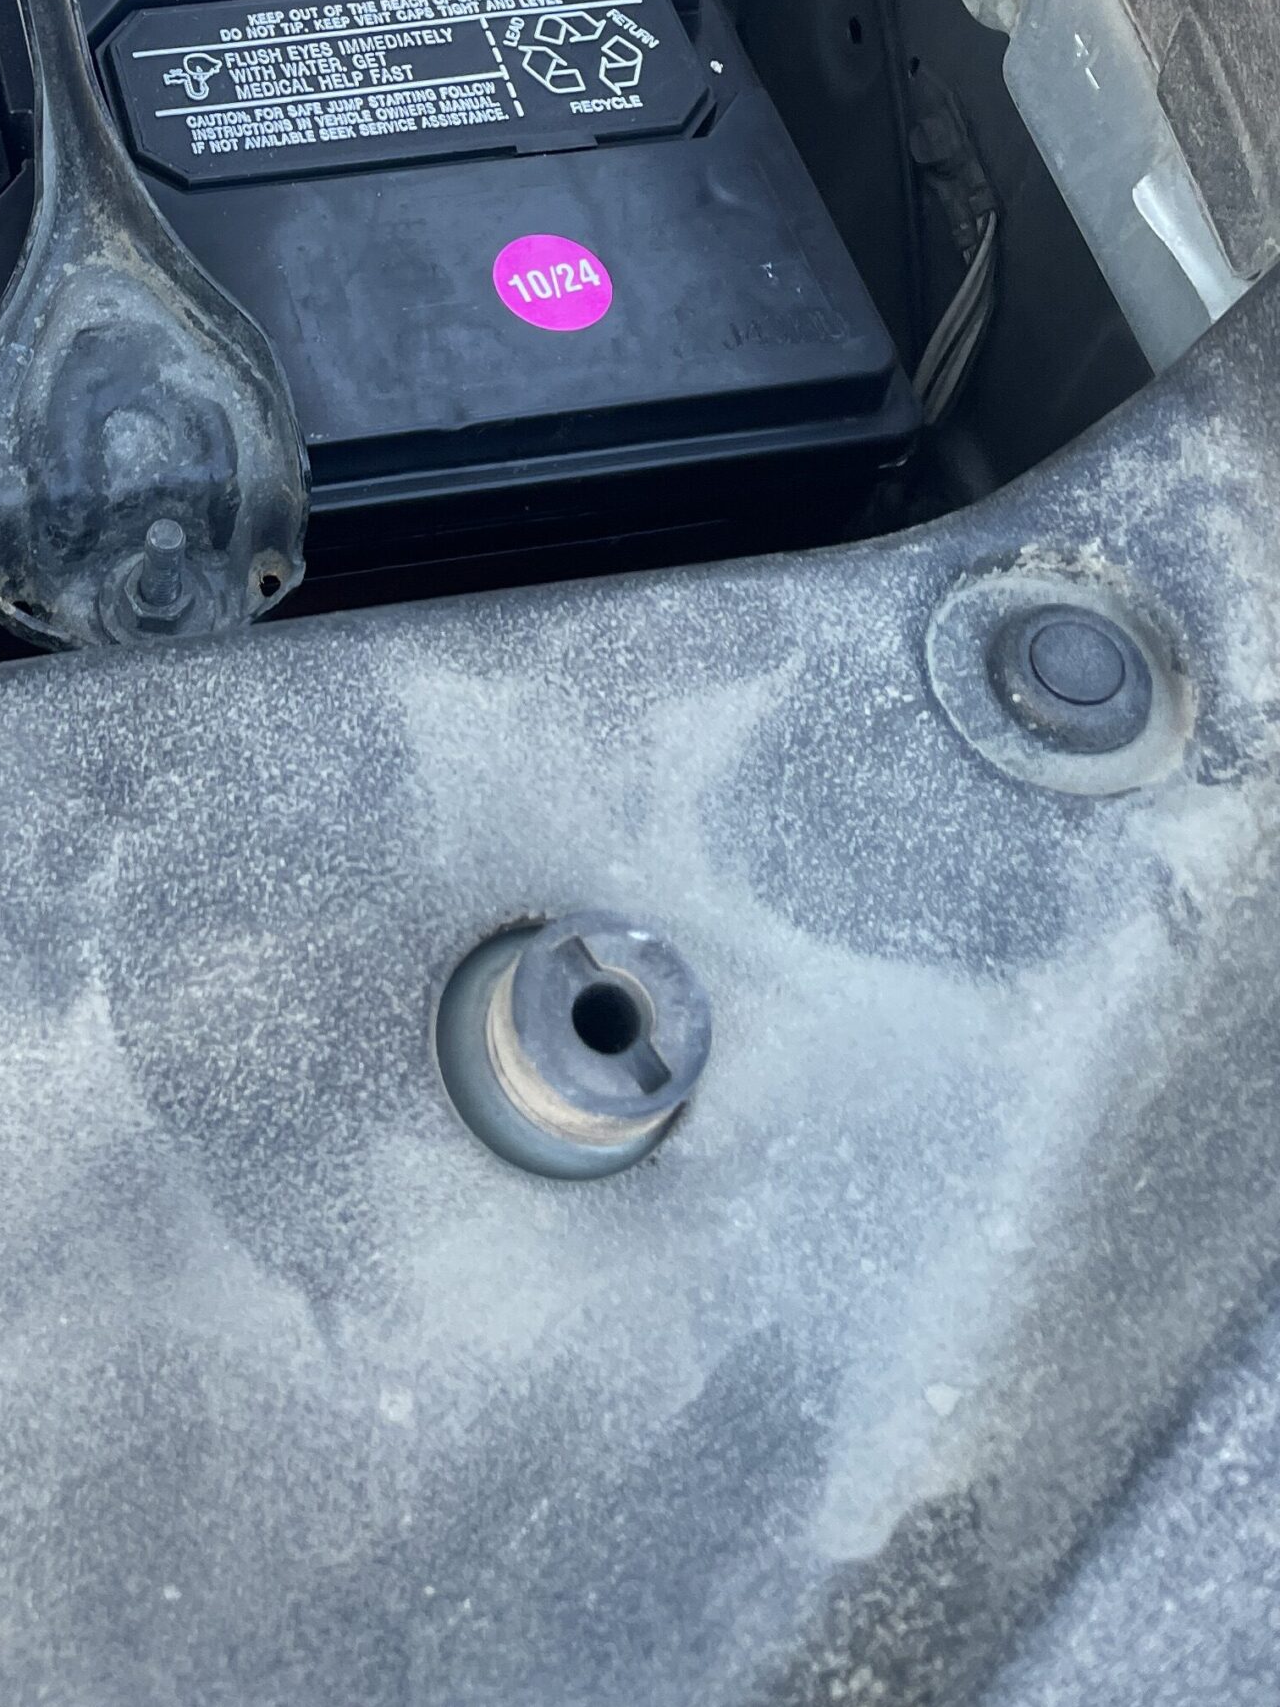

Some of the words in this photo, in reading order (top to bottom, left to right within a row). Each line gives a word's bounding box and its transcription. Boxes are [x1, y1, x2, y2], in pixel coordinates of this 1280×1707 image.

[219, 28, 242, 42] DO
[246, 25, 276, 39] NOT
[280, 22, 309, 35] TIP.
[313, 16, 350, 32] KEEP
[353, 11, 391, 27] VENT
[396, 6, 435, 22] CAPS
[437, 1, 480, 17] TIGHT
[247, 11, 284, 27] KEEP
[288, 7, 318, 21] OUT
[323, 4, 343, 18] OF
[347, 0, 378, 15] THE
[503, 16, 525, 47] LEAD
[606, 8, 660, 49] RETURN
[224, 47, 283, 69] FLUSH
[286, 41, 334, 61] EYES
[338, 27, 453, 56] IMMEDIATELY
[228, 65, 277, 84] WITH
[280, 57, 348, 78] WATER.
[351, 51, 387, 70] GET
[235, 77, 314, 101] MEDICAL
[318, 71, 364, 91] HELP
[369, 64, 414, 85] FAST
[254, 106, 284, 122] FOR
[287, 102, 323, 118] SAFE
[326, 97, 364, 114] JUMP
[368, 90, 437, 109] STARTING
[438, 81, 496, 100] FOLLOW
[190, 119, 293, 141] INSTRUCTIONS
[295, 117, 313, 131] IN
[314, 109, 373, 128] VEHICLE
[375, 103, 436, 121] OWNERS
[439, 95, 501, 113] MANUAL.
[570, 95, 643, 114] RECYCLE
[190, 142, 205, 155] IF
[210, 138, 239, 154] NOT
[244, 130, 317, 150] AVAILABLE
[319, 125, 357, 141] SEEK
[358, 118, 417, 137] SERVICE
[421, 107, 510, 129] ASSISTANCE.
[508, 258, 601, 303] 10/24
